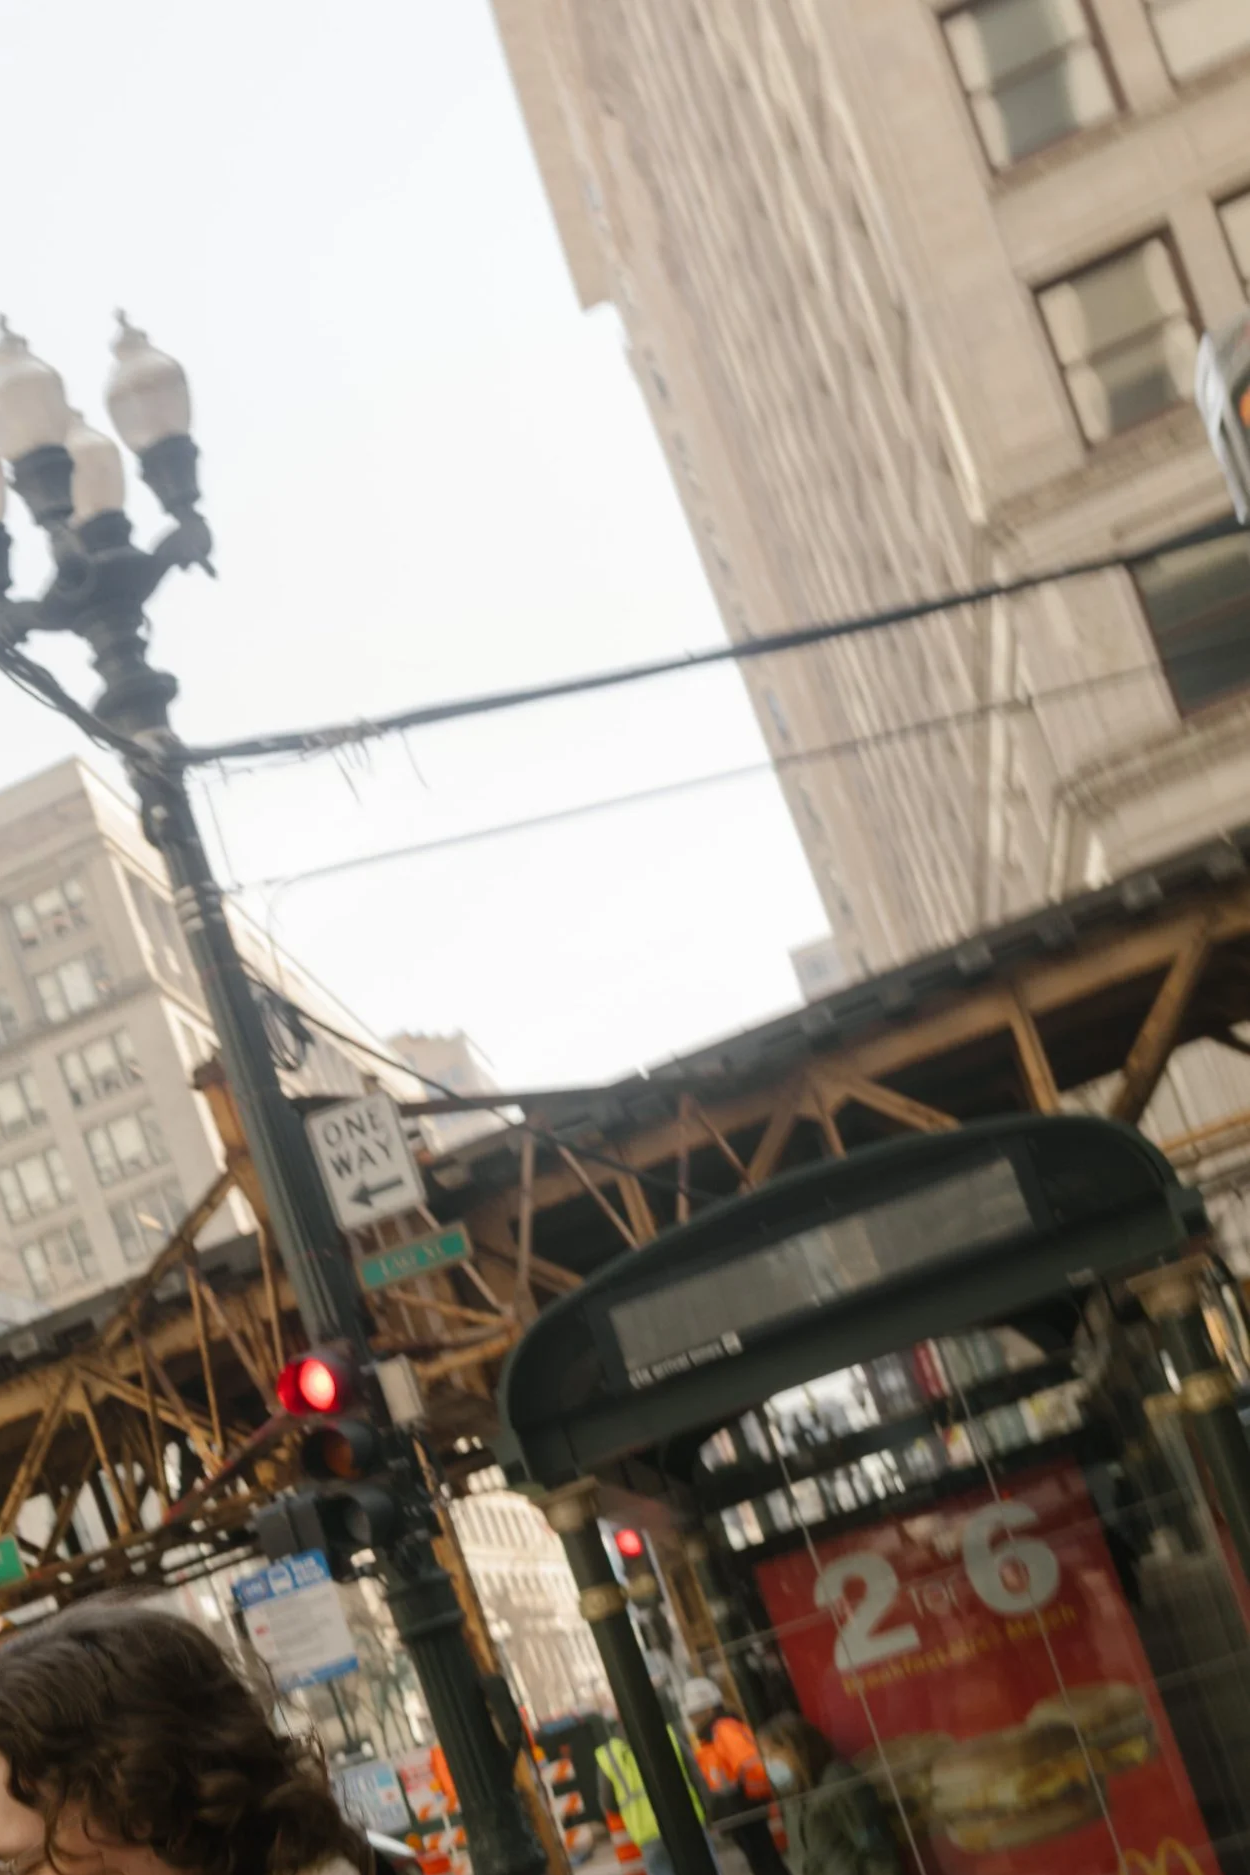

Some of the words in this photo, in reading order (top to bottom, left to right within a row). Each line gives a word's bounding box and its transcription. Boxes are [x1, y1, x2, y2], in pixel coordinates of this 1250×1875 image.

[322, 1106, 386, 1147] ONE
[329, 1138, 394, 1180] WAY
[814, 1551, 922, 1672] 2
